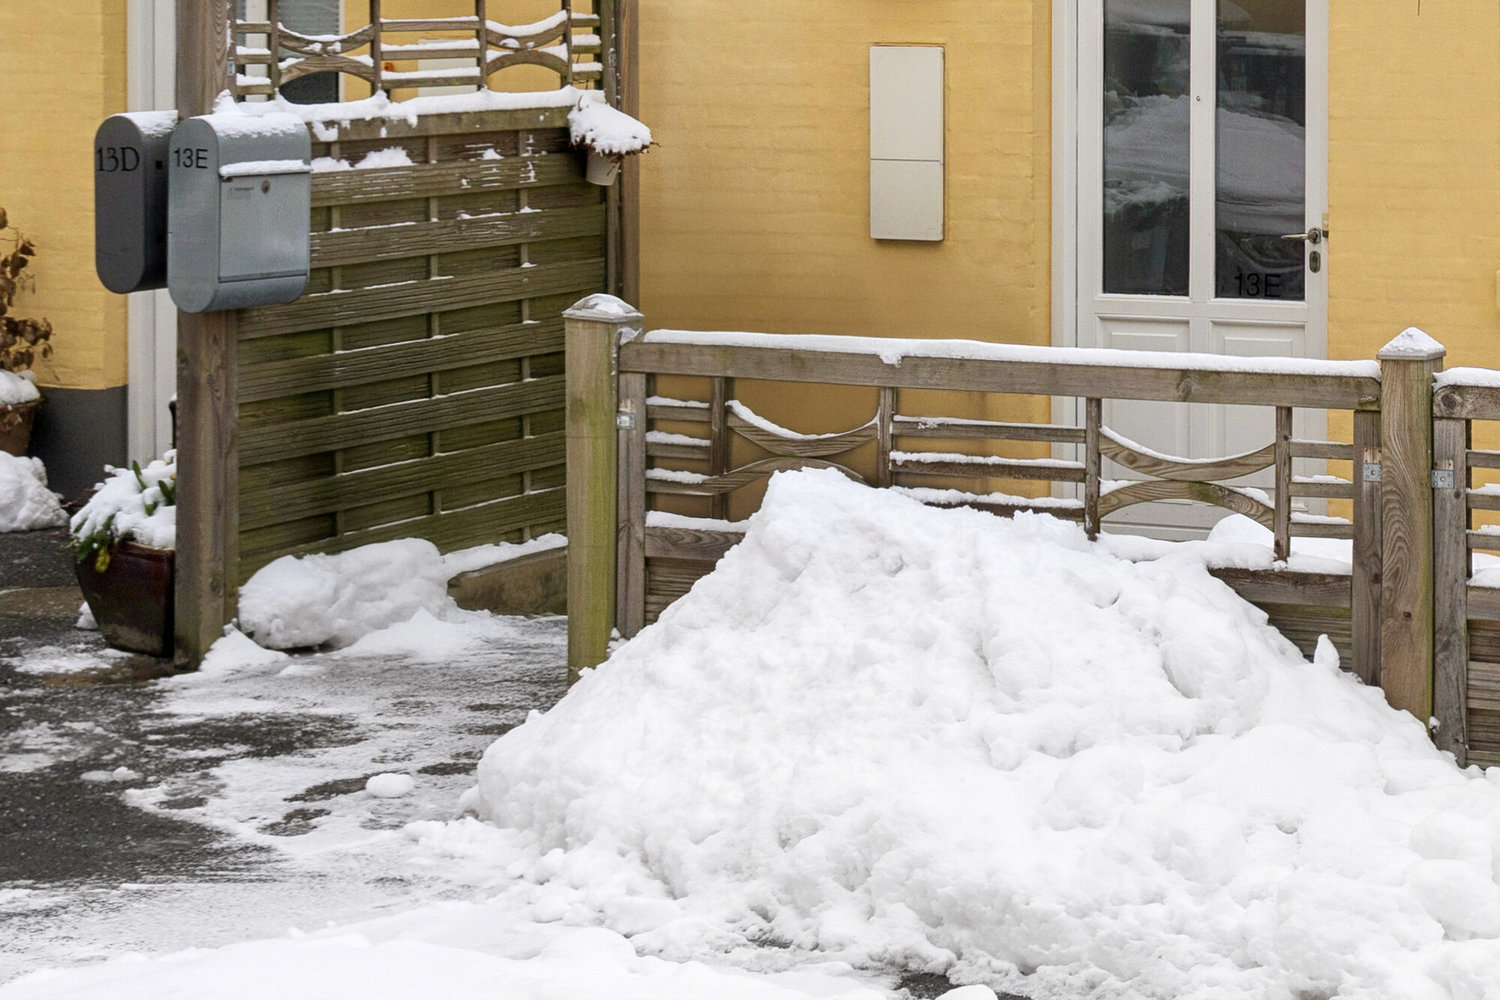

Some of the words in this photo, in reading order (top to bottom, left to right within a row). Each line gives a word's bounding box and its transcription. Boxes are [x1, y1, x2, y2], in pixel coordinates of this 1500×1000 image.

[96, 146, 140, 172] 13D
[174, 148, 208, 169] 13E
[1234, 272, 1281, 298] 13E
